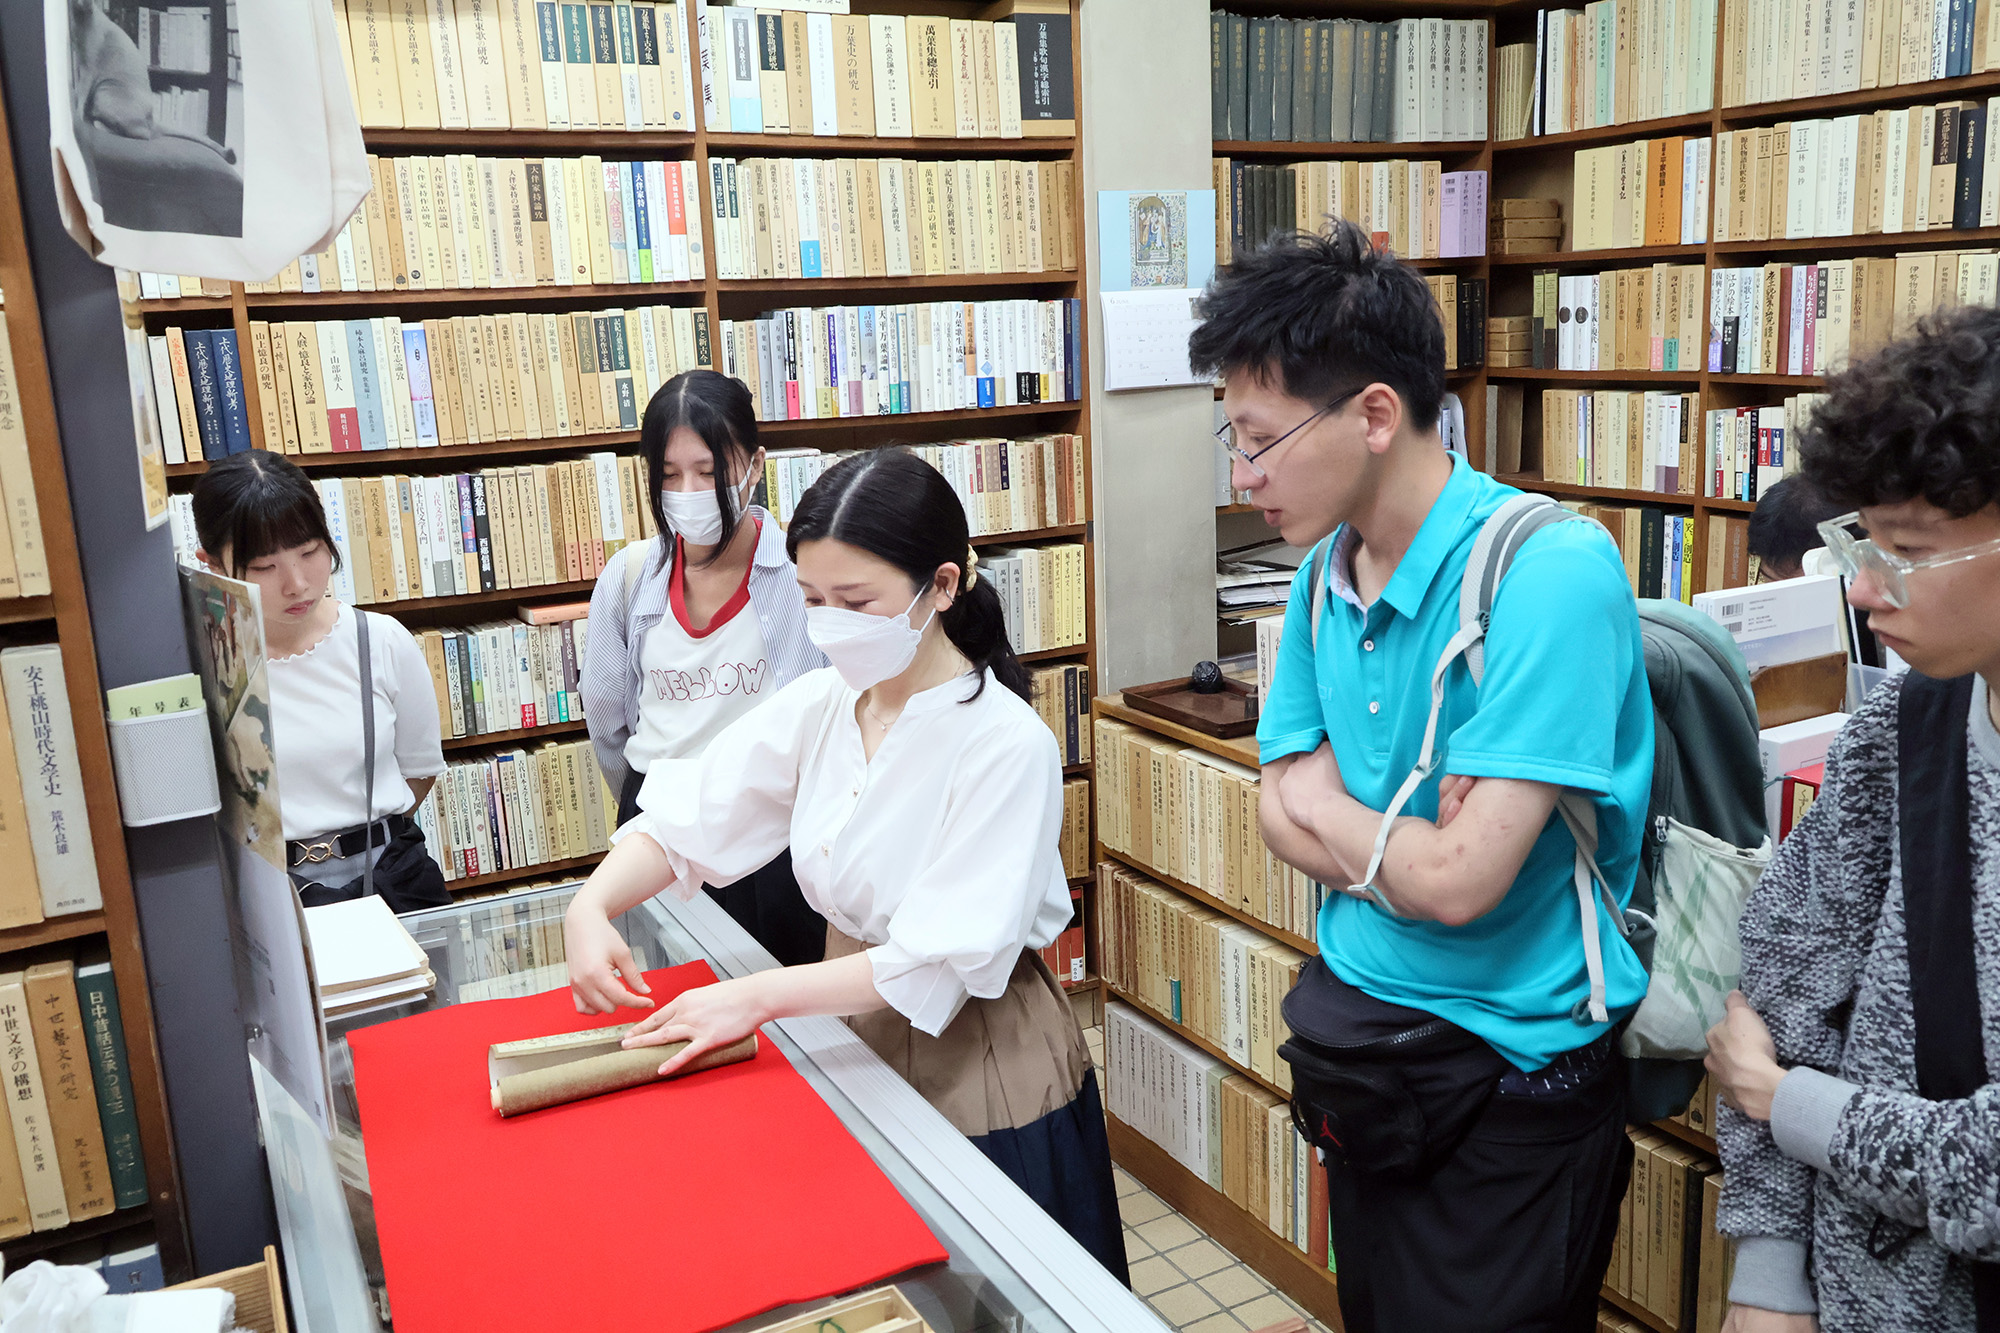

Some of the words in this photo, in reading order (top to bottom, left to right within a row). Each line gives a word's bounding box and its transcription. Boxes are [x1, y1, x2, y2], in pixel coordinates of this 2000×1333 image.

[636, 173, 646, 208] 大伴家持
[255, 332, 272, 389] 山上憶良の研究
[330, 355, 344, 392] 山部赤人
[650, 659, 768, 702] MELLOW
[23, 666, 63, 798] 安土桃山時代文学史
[128, 698, 191, 718] 年号表
[51, 809, 70, 856] 荒木良雄
[0, 1003, 34, 1102] 中世文学の構想
[45, 993, 79, 1102] 中世藝文の研究
[25, 1115, 46, 1172] 佐々木八郎著
